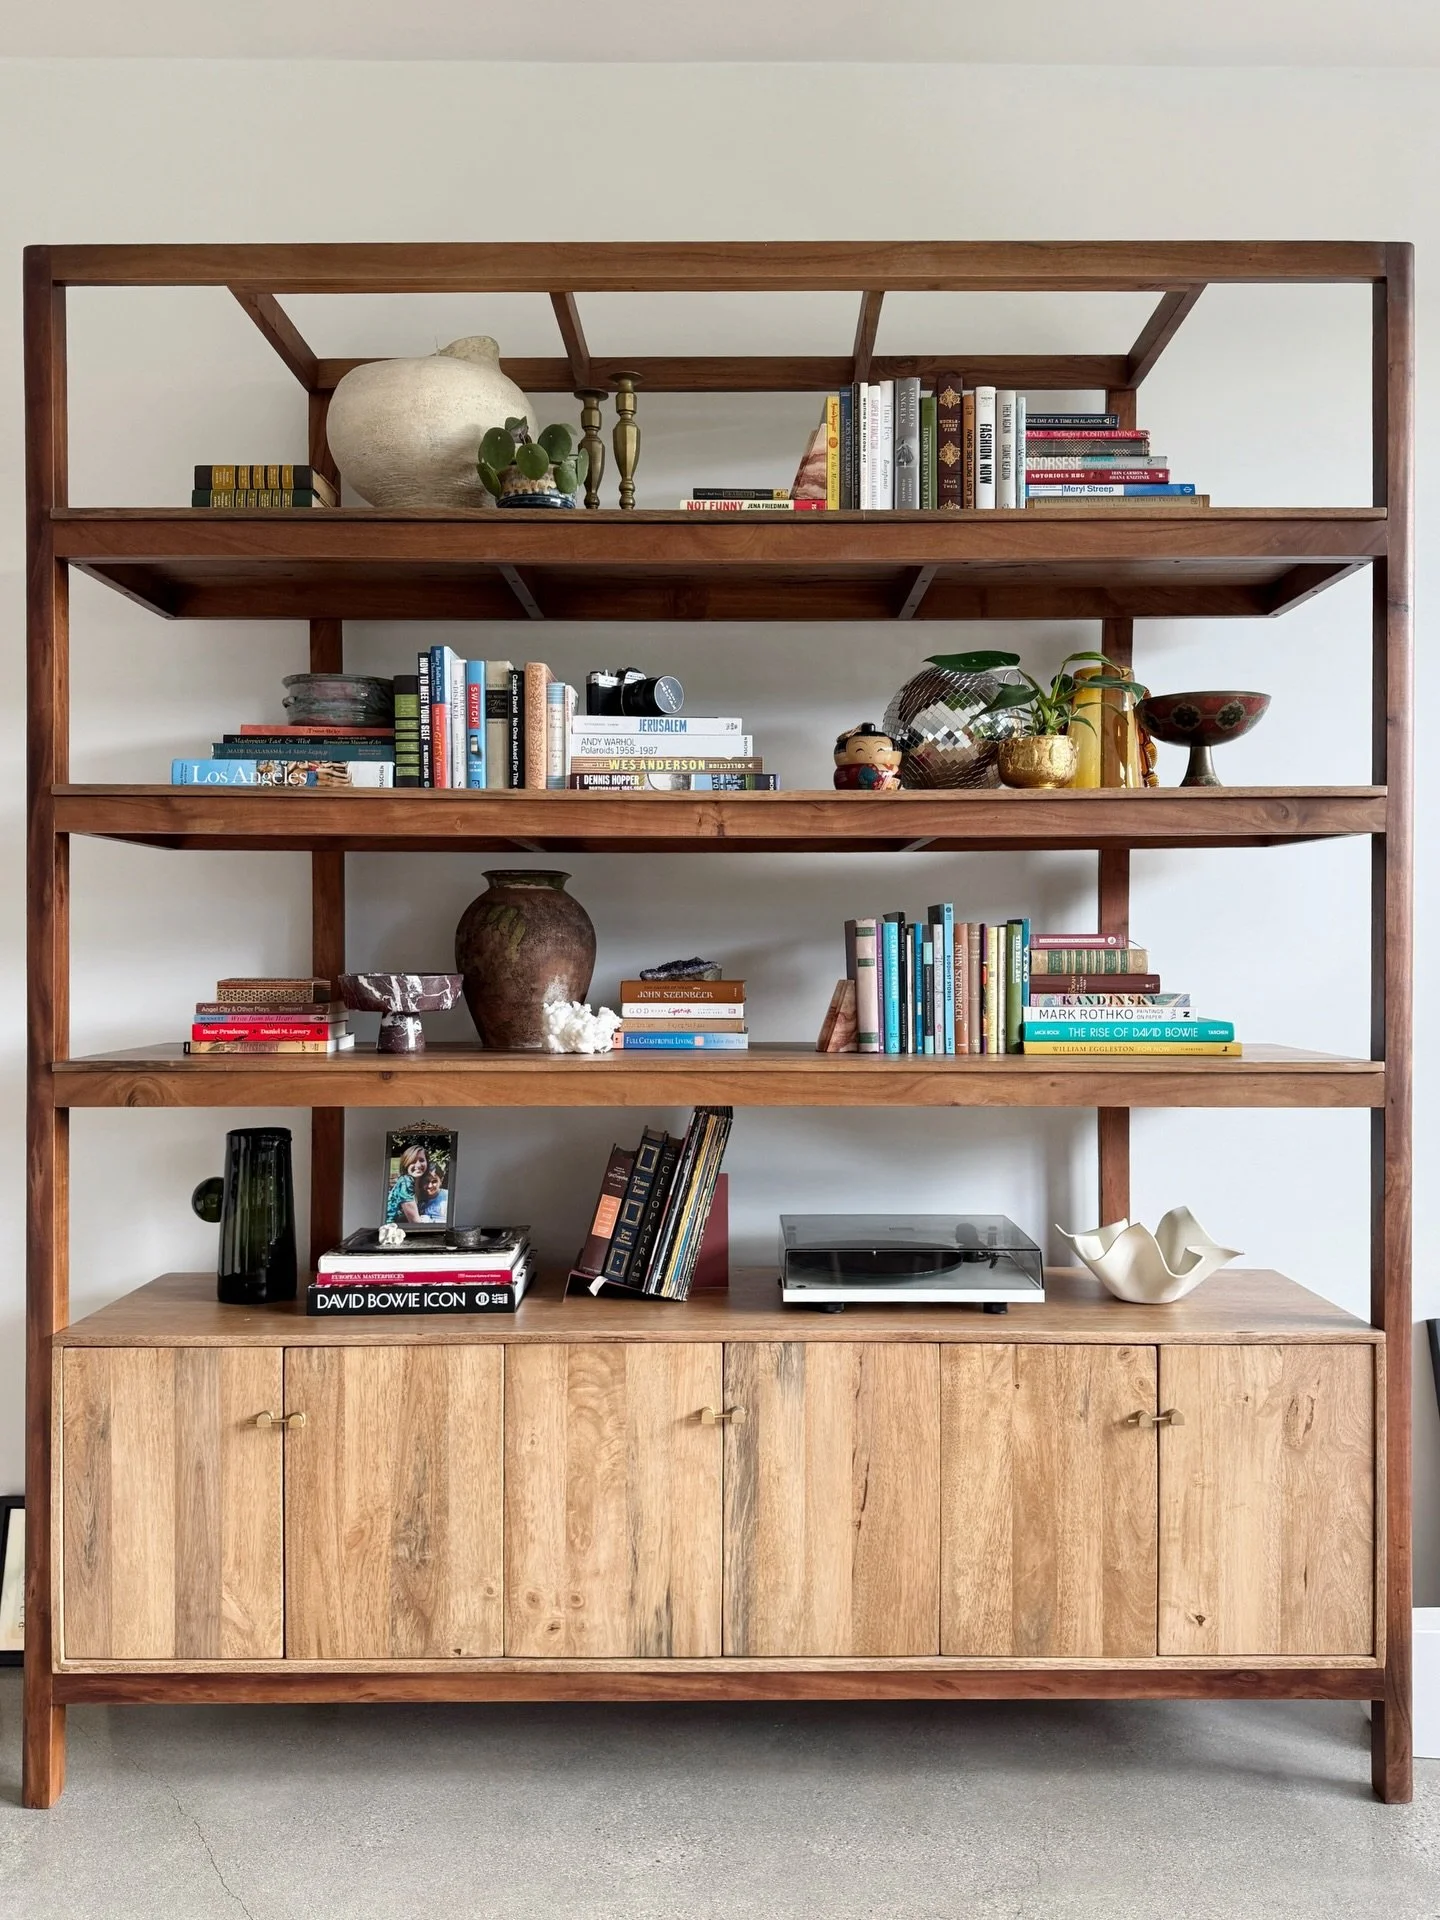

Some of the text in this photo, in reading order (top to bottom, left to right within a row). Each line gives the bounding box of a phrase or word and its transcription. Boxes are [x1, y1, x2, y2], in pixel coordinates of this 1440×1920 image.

[871, 400, 879, 450] SUPER ATTRACTOR
[881, 403, 893, 490] Tina Fey Bossypants
[1002, 404, 1012, 481] THEN AGAIN DIANE KEATON
[980, 423, 993, 485] FASHION NOW
[1026, 457, 1082, 470] SCORSESE
[1063, 485, 1086, 494] Meryl
[1087, 485, 1114, 494] Streep
[687, 501, 706, 510] NOT
[710, 501, 744, 510] FUNNY
[420, 657, 430, 741] HOW TO MEET YOUR SELF
[513, 717, 519, 726] No
[638, 719, 687, 733] JERUSALEM
[434, 732, 442, 761] GUTSY
[581, 737, 636, 746] ANDY WARHOL
[581, 746, 614, 754] Polaroids
[609, 759, 636, 771] WES
[637, 759, 706, 771] ANDERSON
[192, 765, 228, 784] Los
[232, 766, 307, 786] Angeles
[583, 775, 611, 786] DENNIS
[611, 775, 639, 786] HOPPER
[1062, 994, 1158, 1006] KANDINSKY
[201, 1005, 219, 1013] Angel
[219, 1005, 231, 1013] City
[255, 1005, 270, 1013] Plays
[279, 1005, 303, 1013] Shepard
[1039, 1009, 1075, 1020] MARK
[1080, 1008, 1134, 1020] ROTHKO
[1069, 1027, 1198, 1037] THE RISE OF DAVID BOWIE
[675, 1037, 694, 1045] LIVING
[635, 1165, 669, 1268] CLEOPATRA
[317, 1292, 466, 1309] DAVID BOWIE ICON
